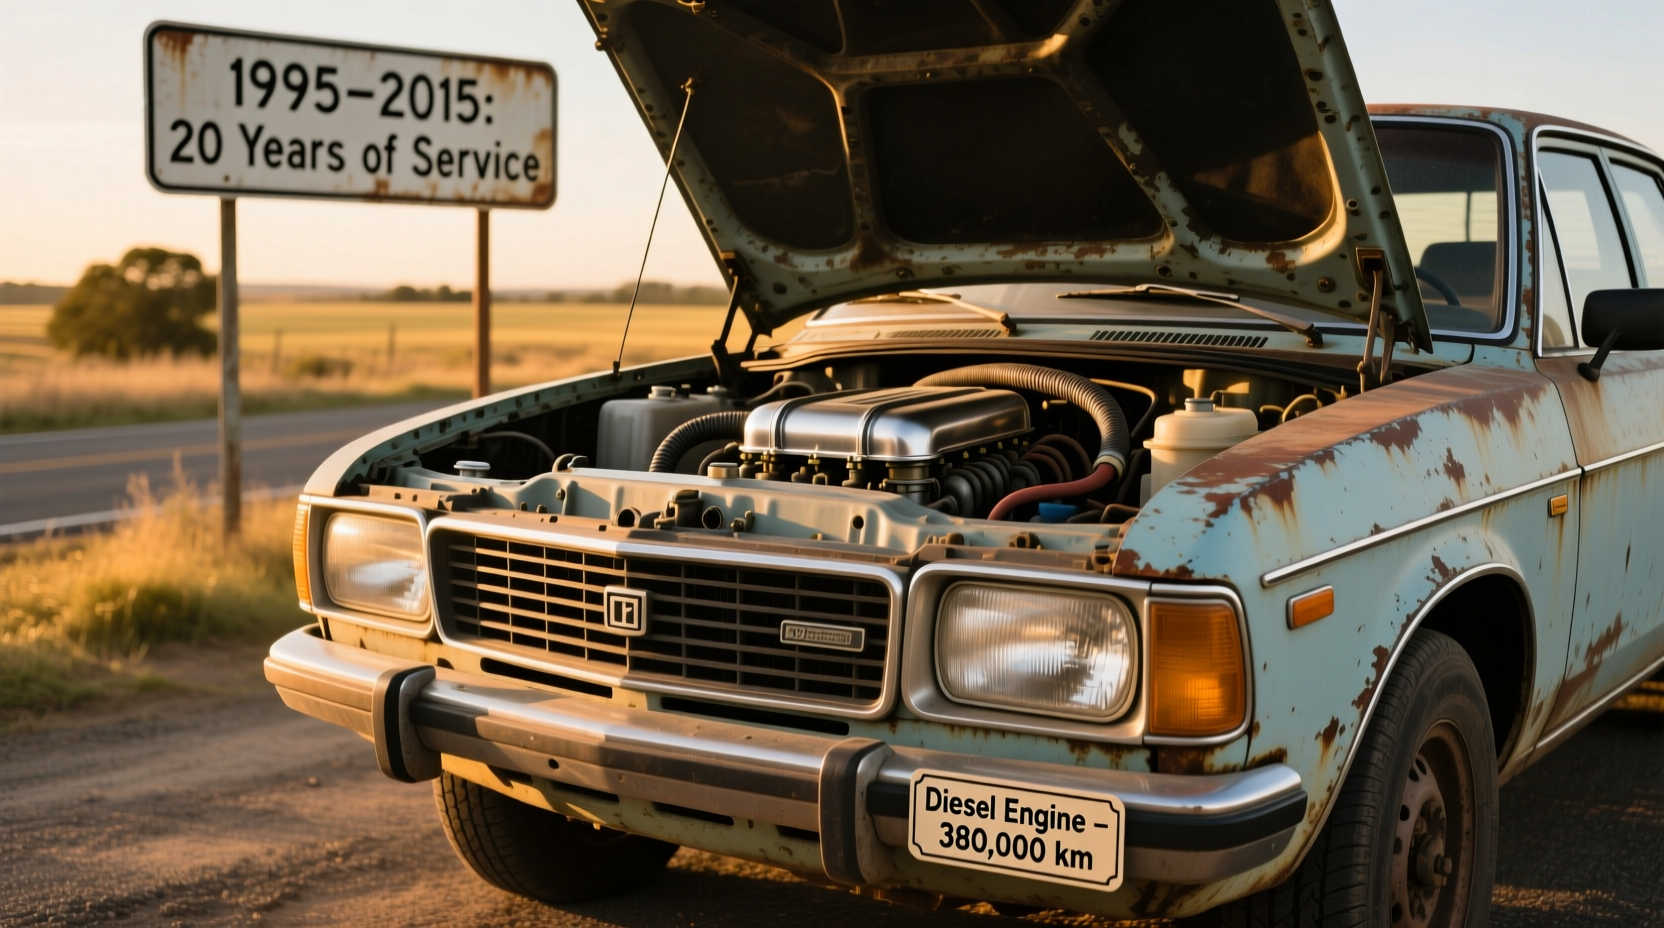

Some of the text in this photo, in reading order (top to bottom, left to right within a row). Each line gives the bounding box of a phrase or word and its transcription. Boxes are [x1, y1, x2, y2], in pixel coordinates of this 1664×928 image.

[229, 57, 494, 125] 1995–2015:
[170, 118, 540, 183] 20 Years of Service
[925, 786, 996, 820] Diesel
[1004, 797, 1087, 834] Engine
[939, 821, 1093, 871] 380,000 km
